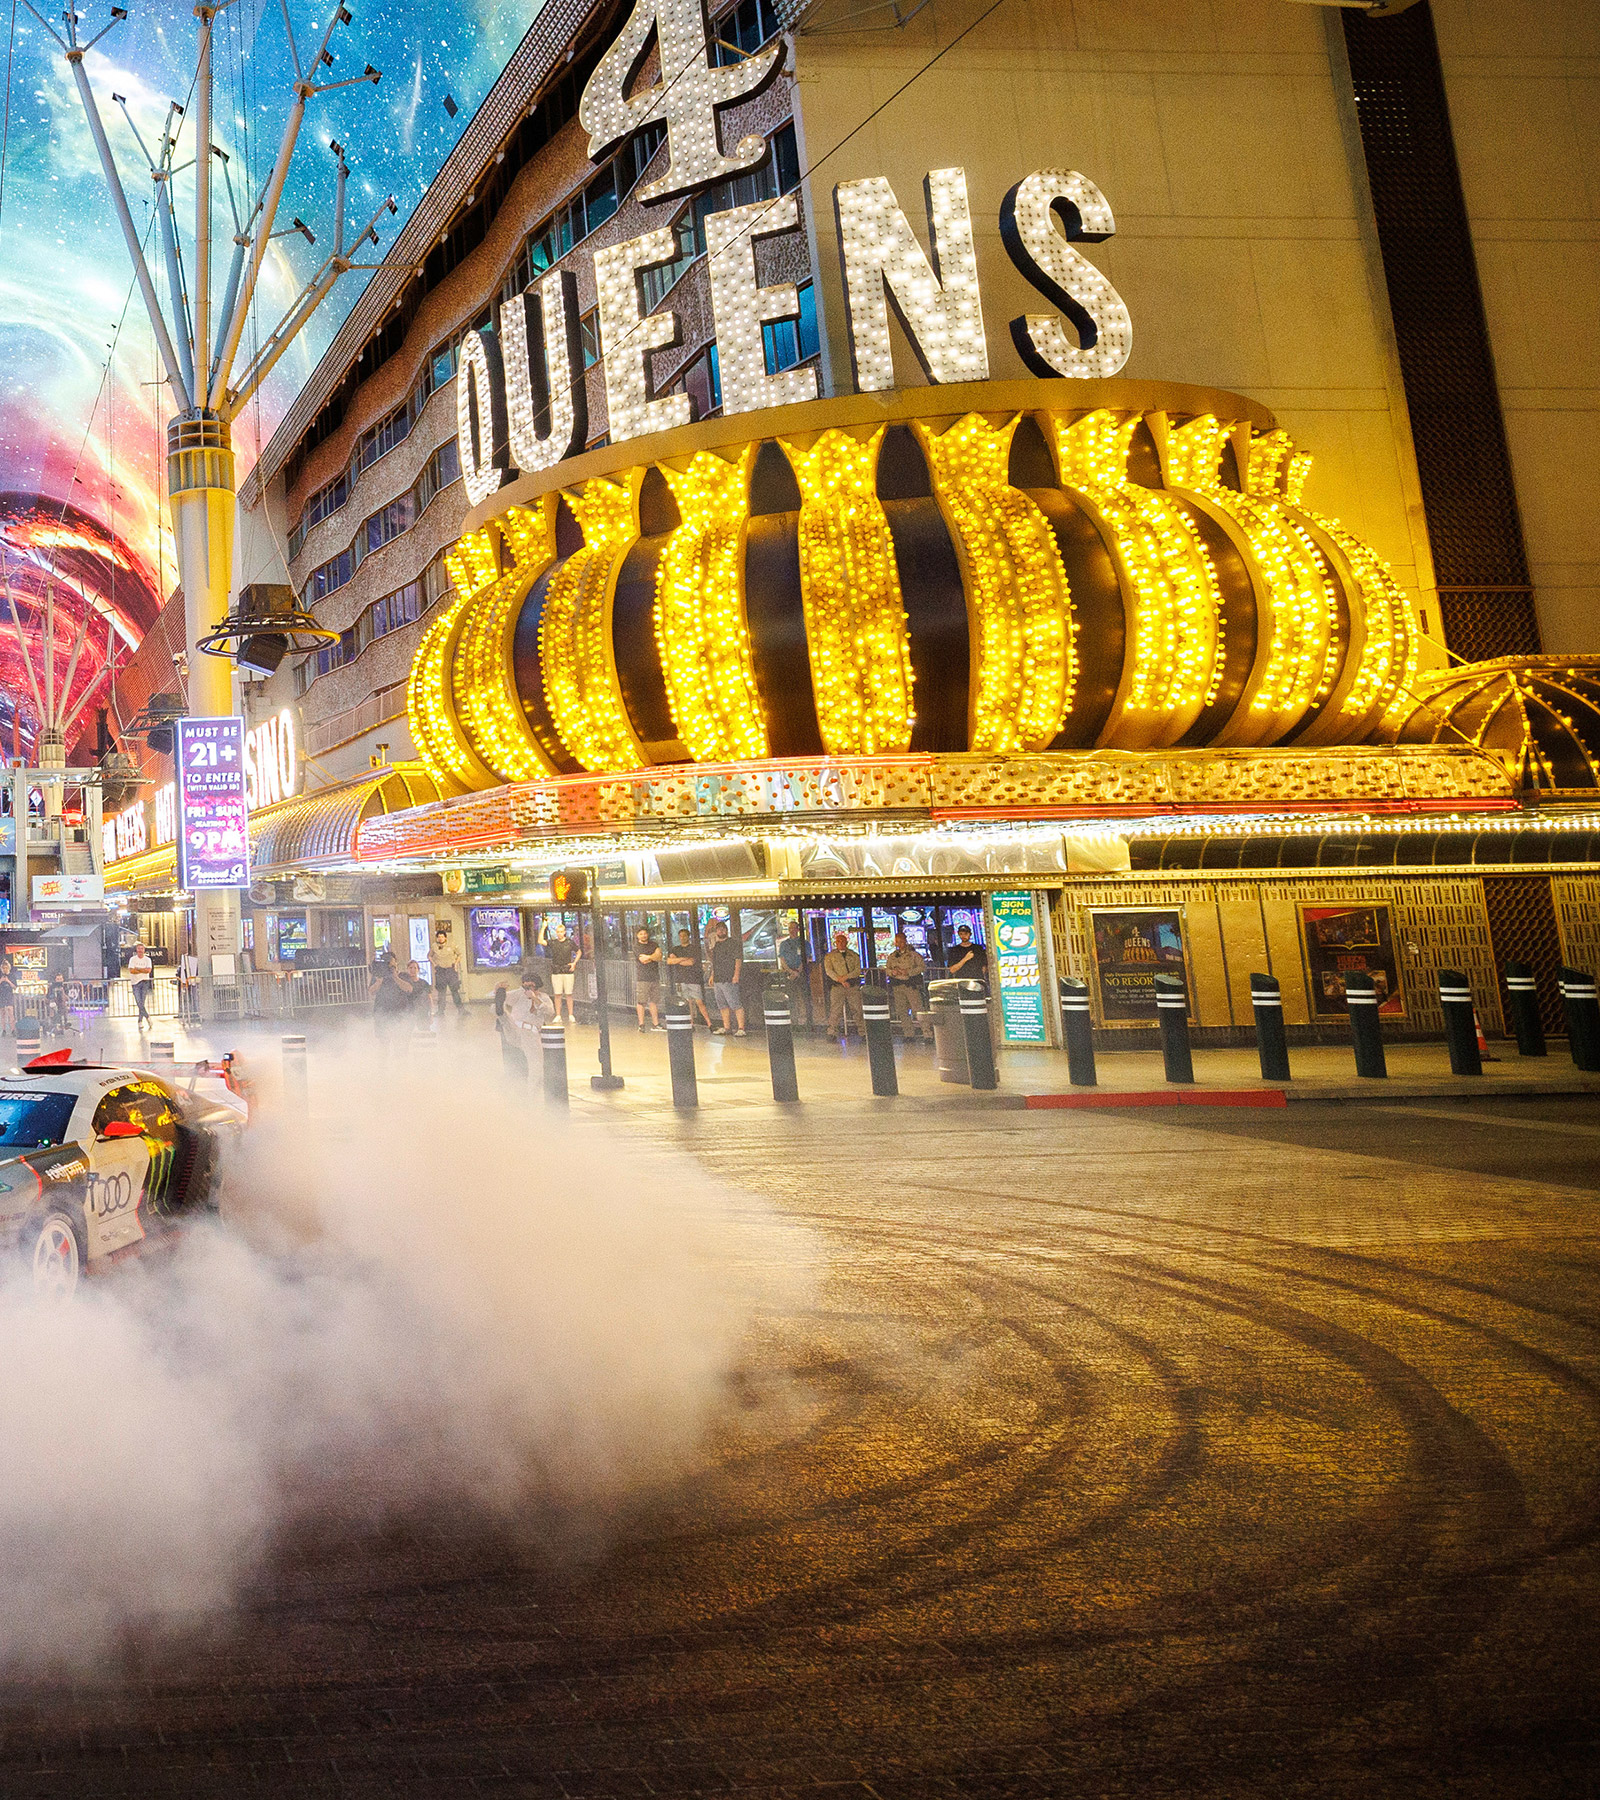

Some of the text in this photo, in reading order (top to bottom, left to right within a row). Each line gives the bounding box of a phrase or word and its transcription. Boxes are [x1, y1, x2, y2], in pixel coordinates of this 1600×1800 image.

[580, 0, 786, 205] 4
[456, 166, 1132, 506] QUEENS
[185, 726, 238, 738] MUST BE
[189, 742, 237, 767] 21+
[155, 780, 177, 845] HOT
[245, 708, 296, 810] SINO
[186, 772, 241, 784] TO ENTER
[208, 783, 228, 792] VALID
[187, 806, 206, 818] FRI
[216, 805, 243, 817] SUN
[1000, 925, 1030, 947] $5
[1125, 937, 1151, 948] QUEENS
[1000, 955, 1037, 966] FREE
[1001, 965, 1039, 977] SLOT
[1001, 976, 1040, 988] PLAY
[1105, 977, 1155, 986] NO RESOR
